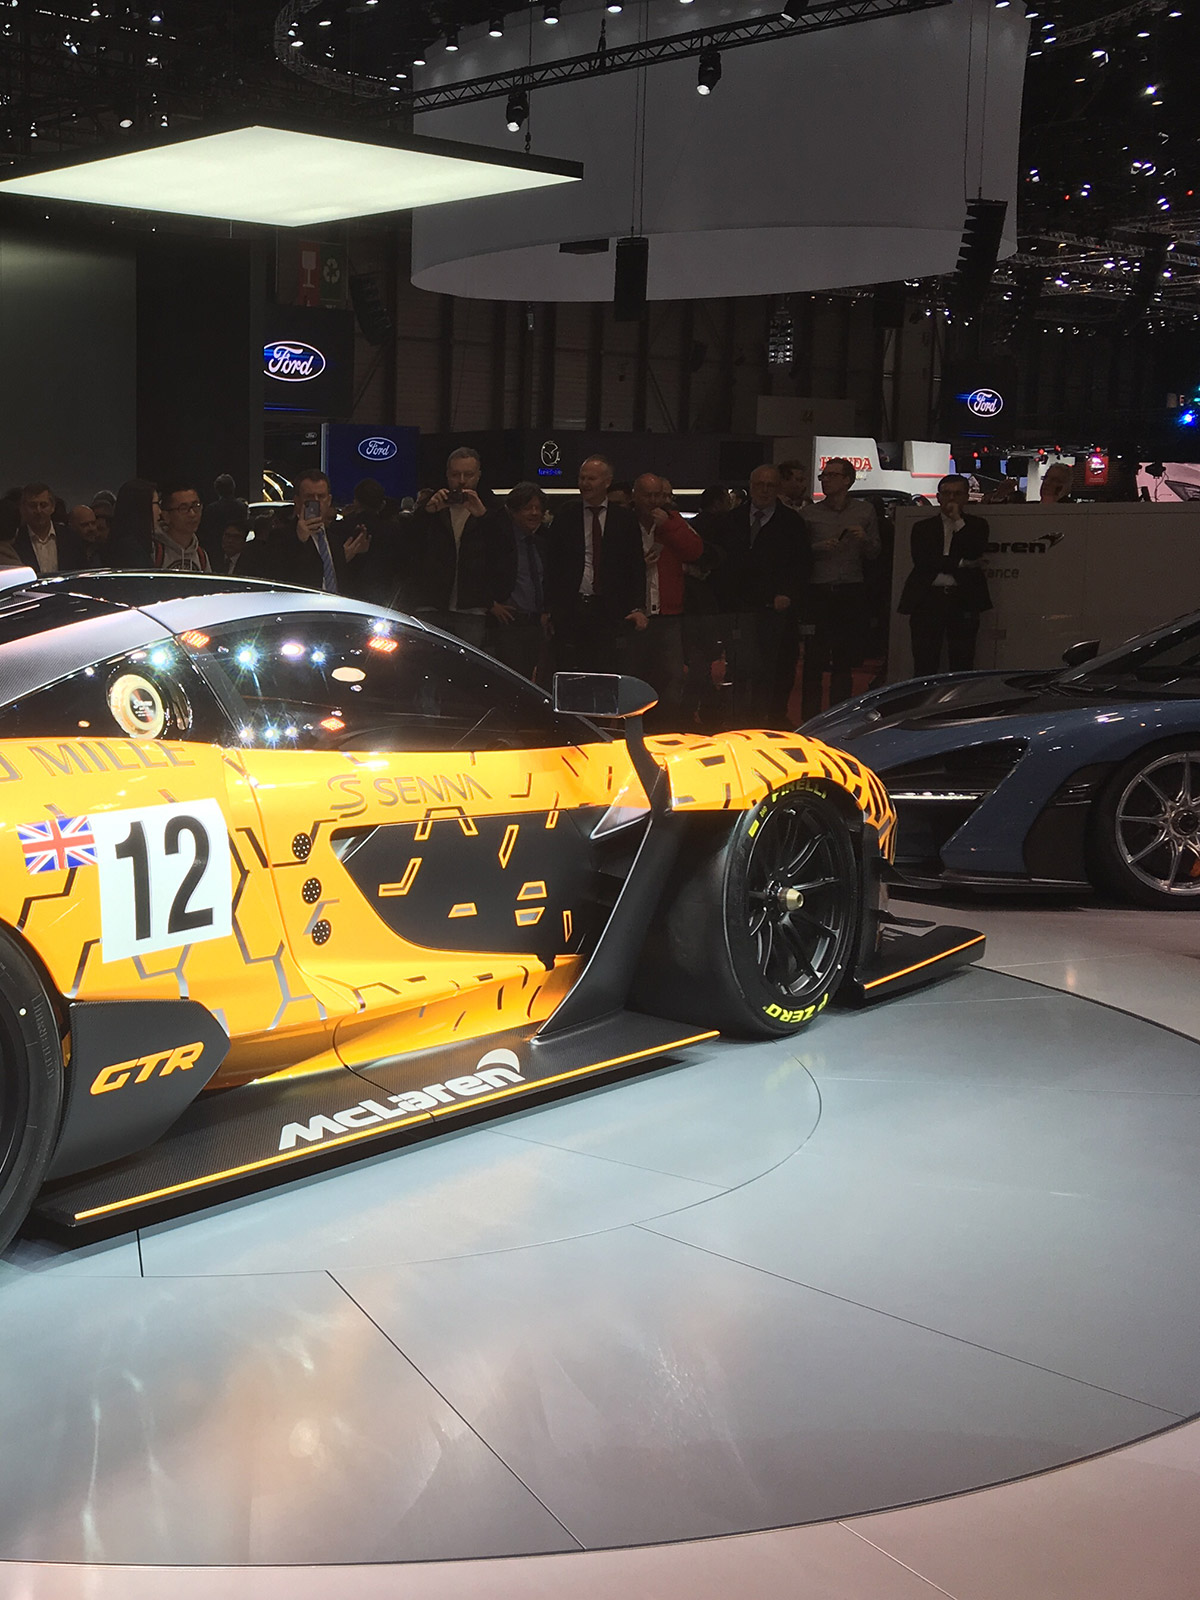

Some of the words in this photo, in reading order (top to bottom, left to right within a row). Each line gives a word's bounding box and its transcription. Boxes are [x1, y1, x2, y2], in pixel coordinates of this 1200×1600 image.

[268, 345, 315, 376] Ford
[973, 391, 998, 412] Ford
[365, 439, 391, 456] Ford
[819, 456, 873, 471] HDA
[27, 739, 197, 777] MILLE
[373, 773, 494, 807] SENNA
[114, 815, 215, 942] 12
[765, 1003, 816, 1024] ZERO
[89, 1040, 205, 1096] GTR
[278, 1067, 526, 1151] McLaren
